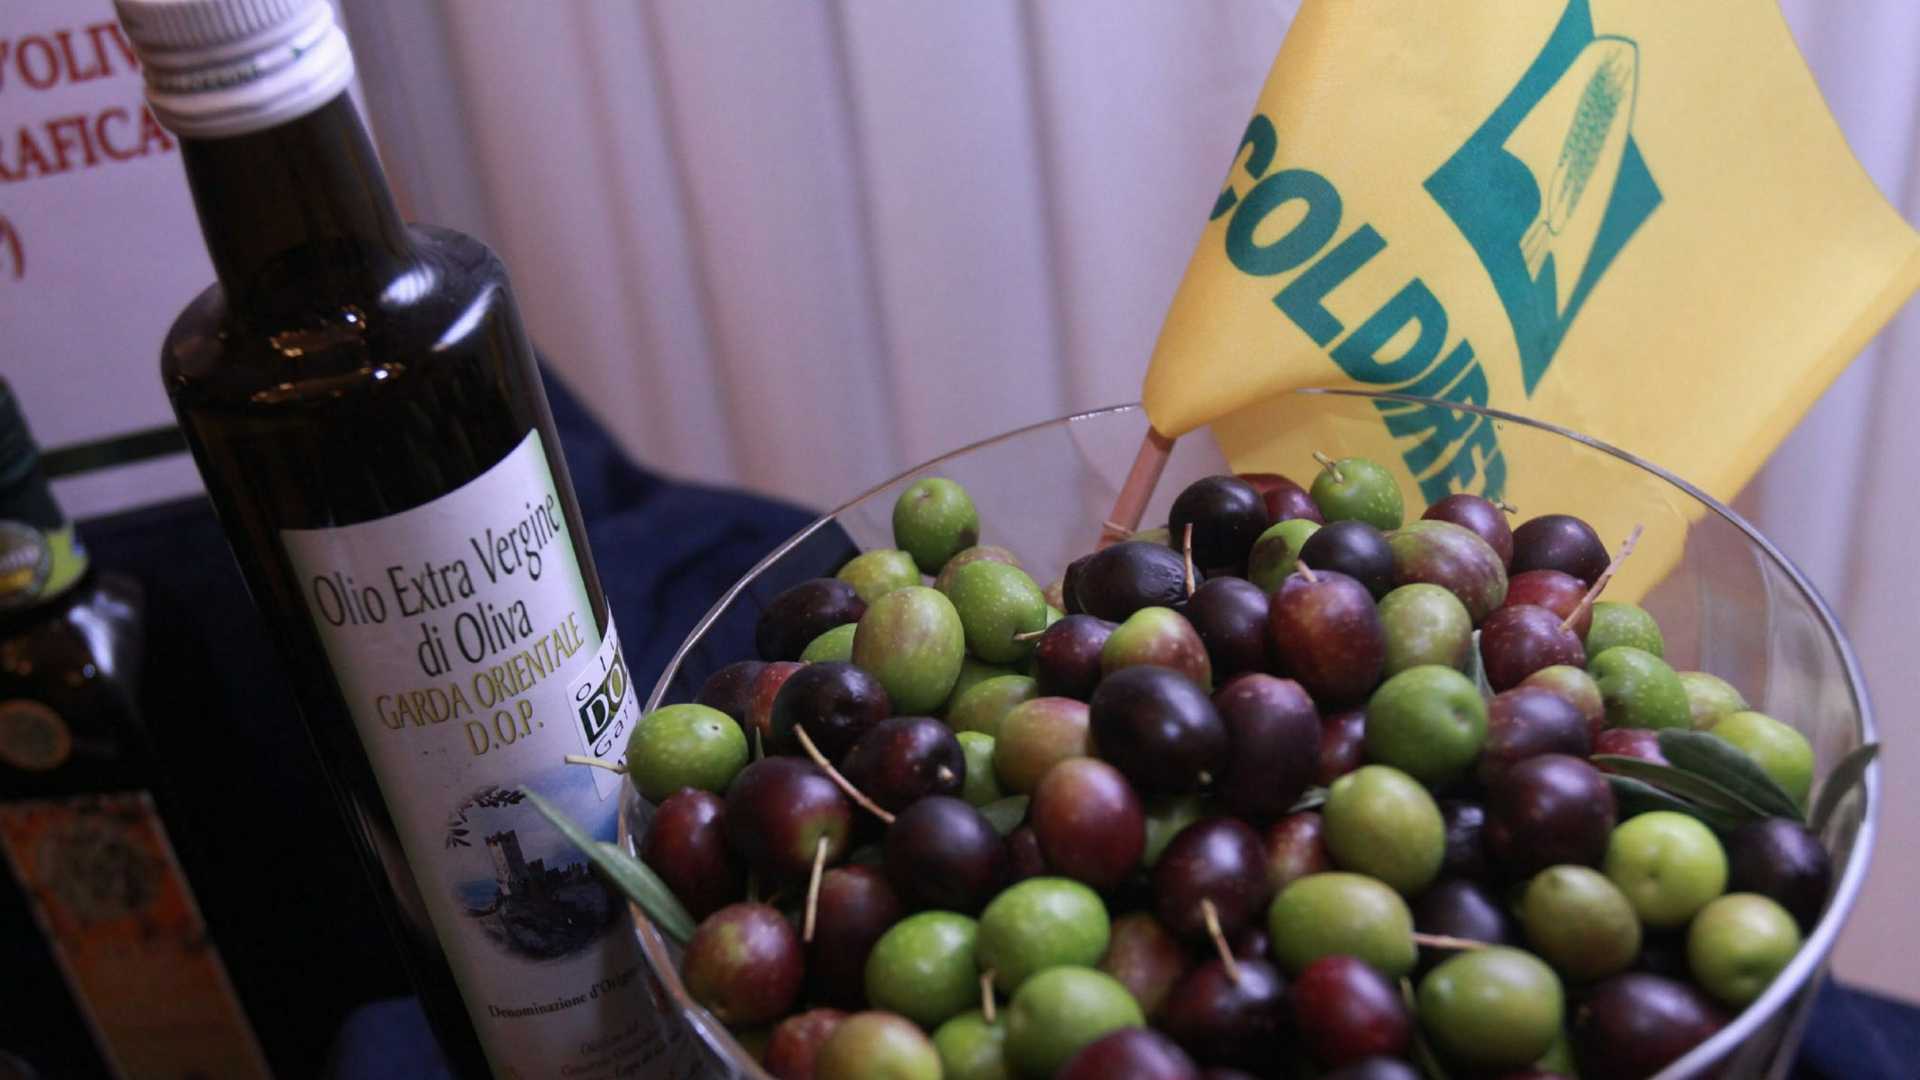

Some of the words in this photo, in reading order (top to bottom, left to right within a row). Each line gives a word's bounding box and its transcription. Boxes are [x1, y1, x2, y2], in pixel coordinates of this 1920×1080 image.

[312, 572, 387, 627] Olio
[386, 559, 476, 618] Extra
[470, 493, 560, 582] Vergine
[375, 682, 473, 730] GARDA
[470, 610, 585, 708] ORIENTALE
[417, 622, 450, 678] di
[454, 599, 534, 664] Oliva
[463, 699, 545, 757] D.O.P.
[488, 993, 587, 1018] Denominazione
